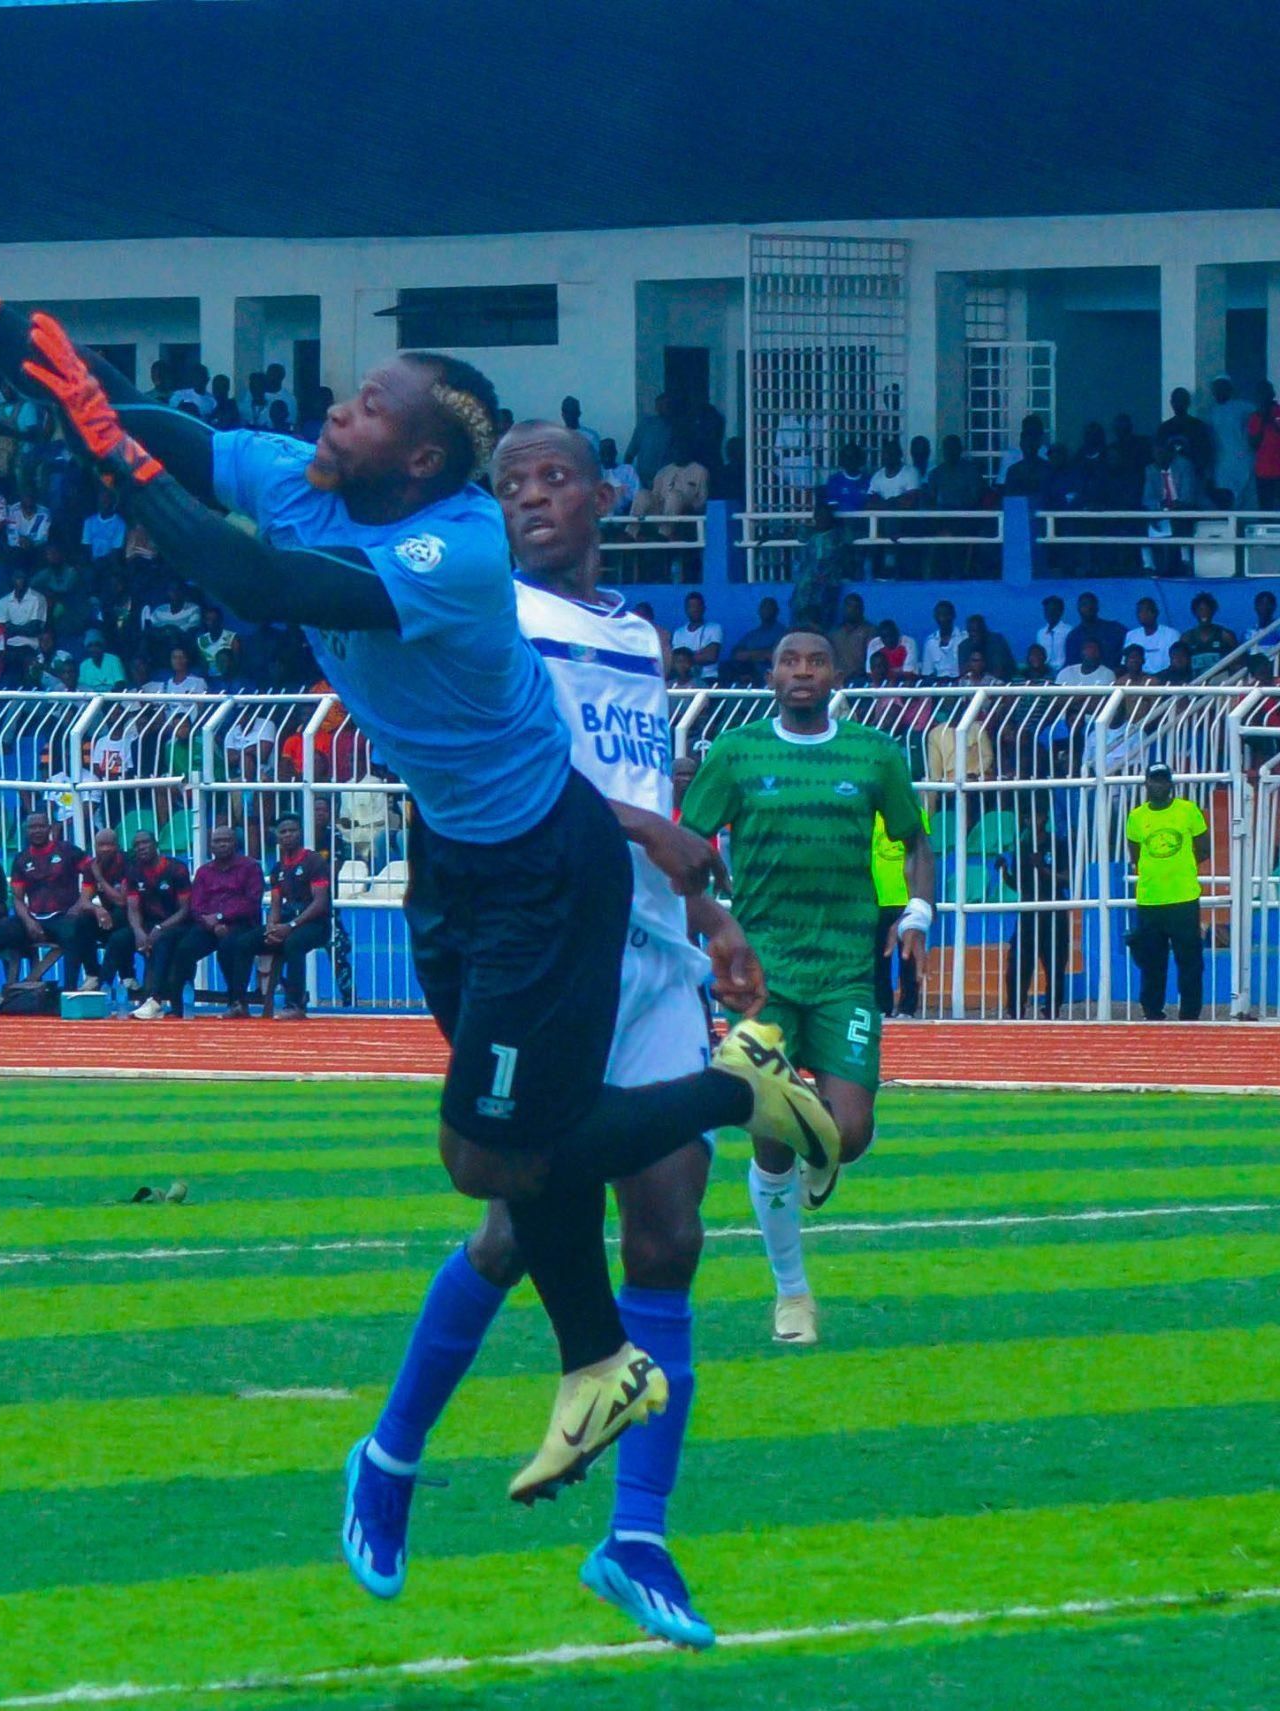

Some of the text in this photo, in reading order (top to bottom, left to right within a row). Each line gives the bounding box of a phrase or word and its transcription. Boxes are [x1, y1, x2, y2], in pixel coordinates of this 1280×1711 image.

[581, 702, 670, 745] BAYELS
[847, 1007, 871, 1044] 2
[491, 1043, 518, 1098] 1
